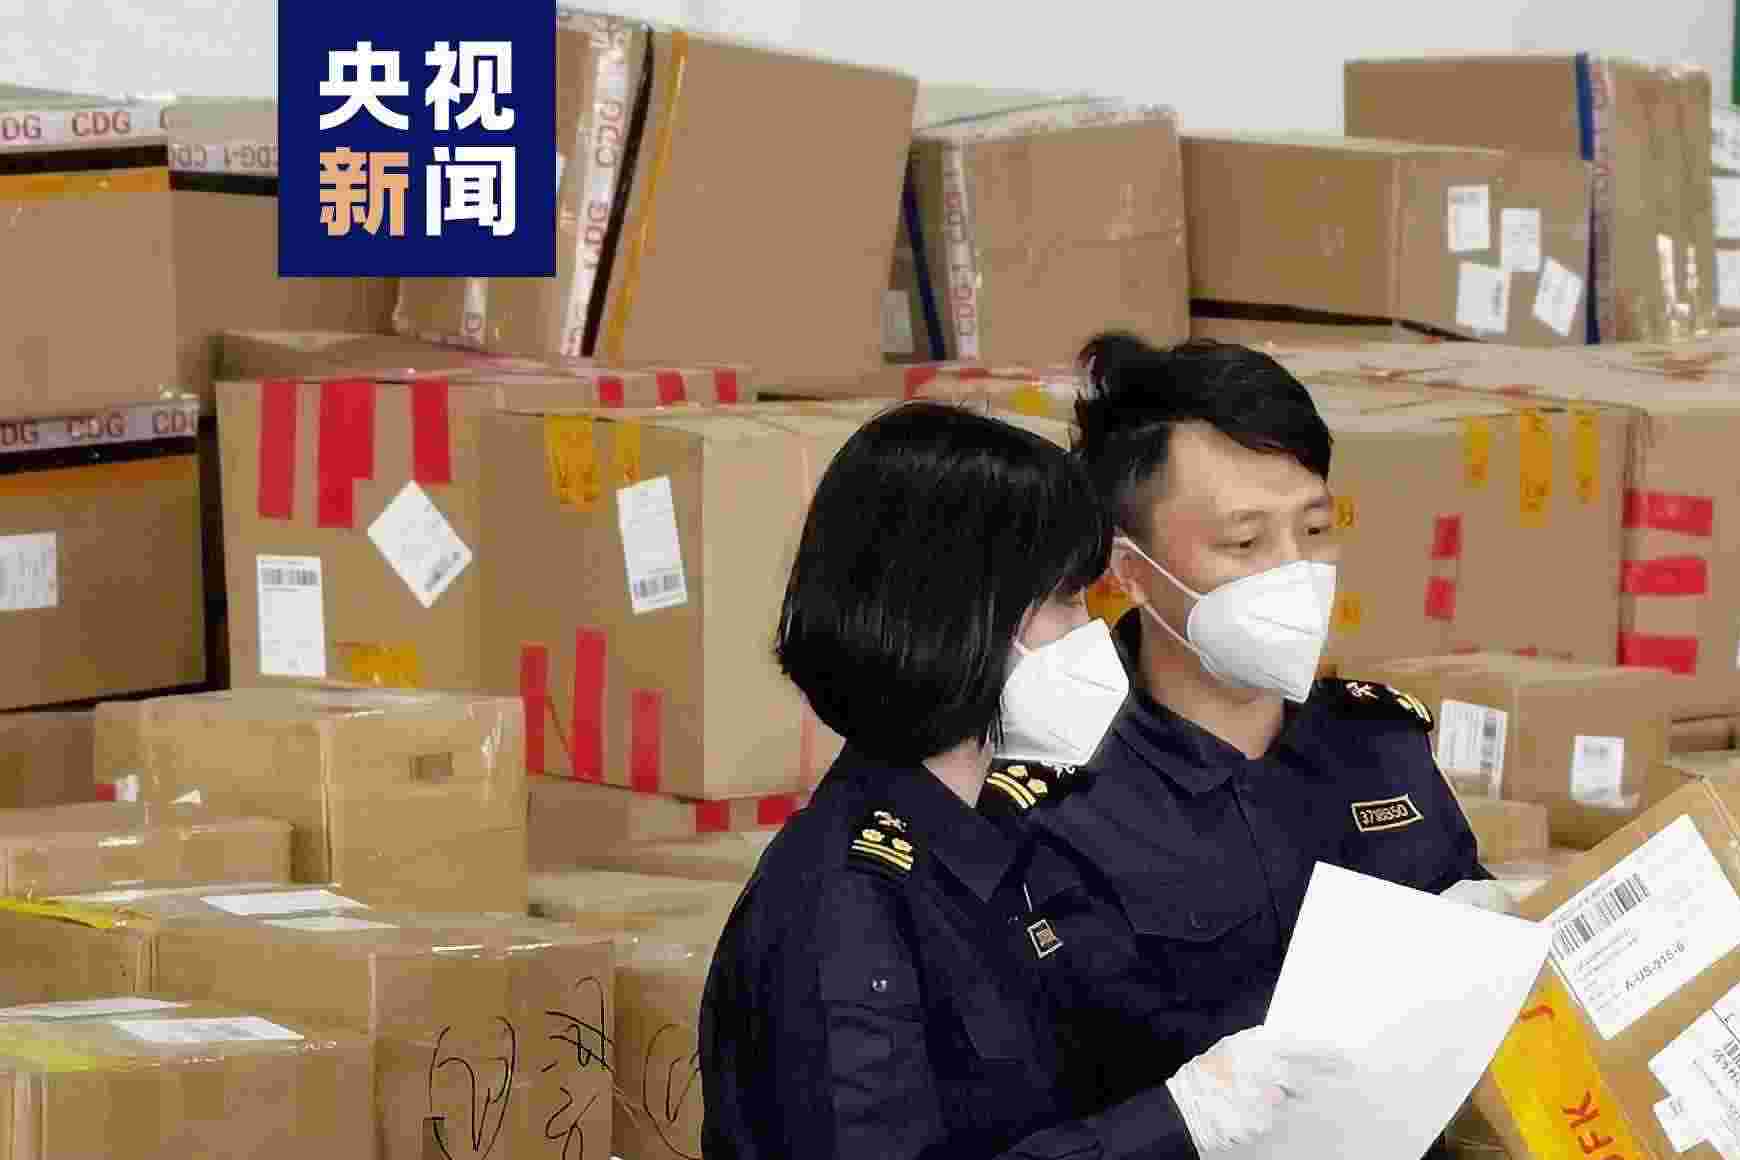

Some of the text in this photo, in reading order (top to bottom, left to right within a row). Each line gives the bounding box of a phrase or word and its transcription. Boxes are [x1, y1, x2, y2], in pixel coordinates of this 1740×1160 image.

[0, 113, 42, 141] DG
[71, 109, 131, 138] CDG
[0, 417, 39, 446] DG
[65, 410, 128, 441] CDG
